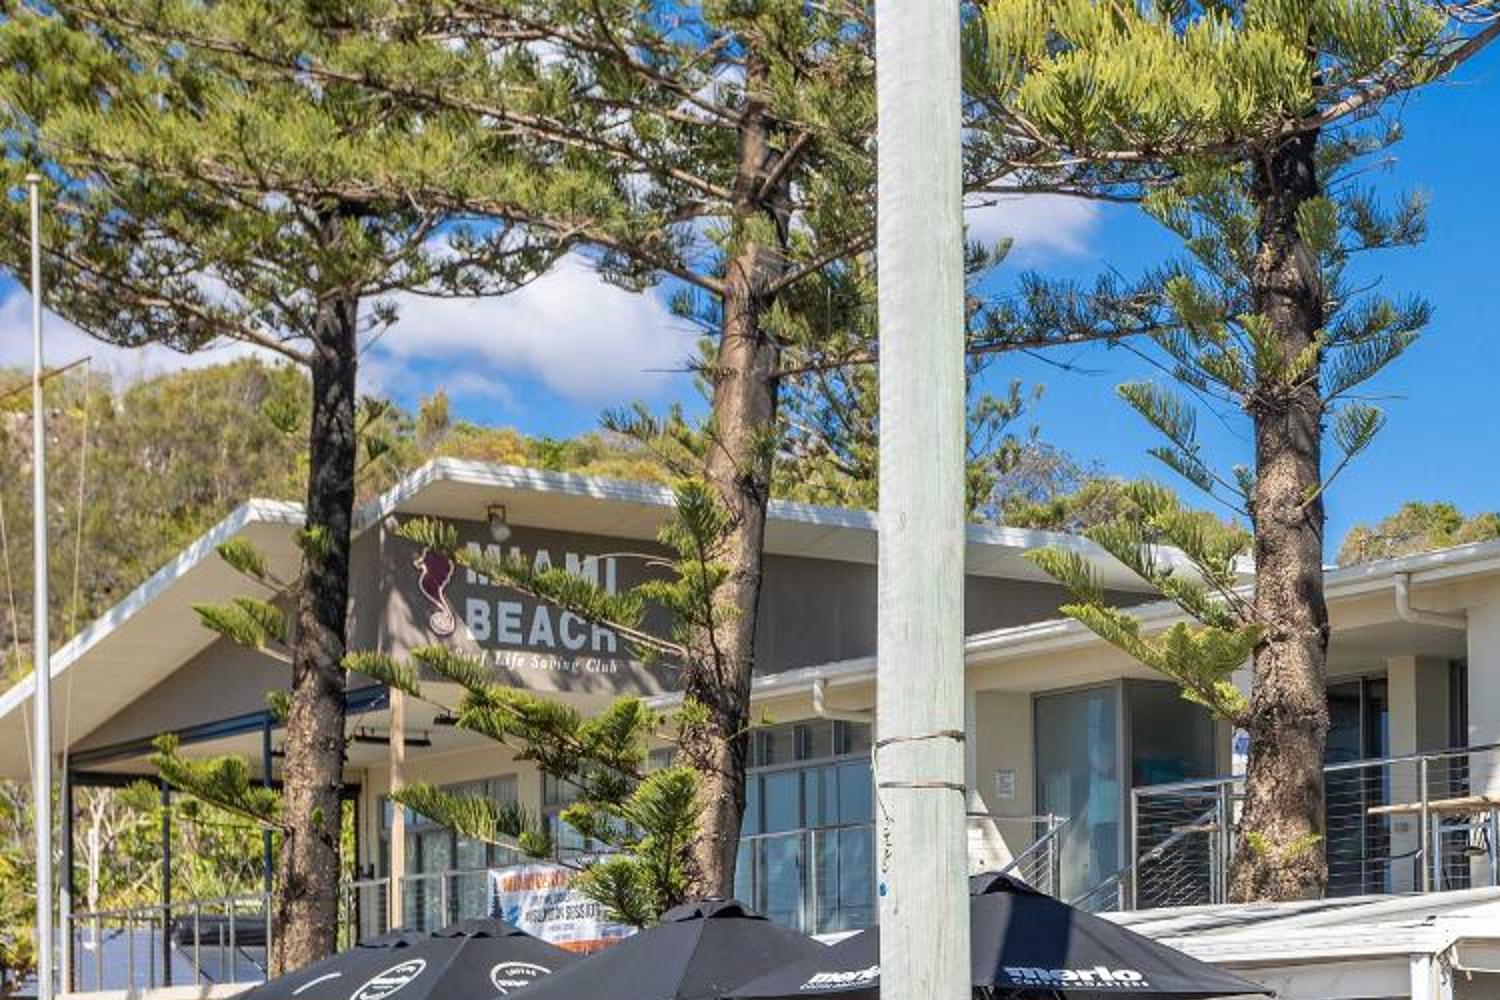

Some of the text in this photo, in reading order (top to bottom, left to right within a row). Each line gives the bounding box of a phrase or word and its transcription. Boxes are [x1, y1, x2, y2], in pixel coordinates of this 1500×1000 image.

[466, 597, 617, 652] BEACH
[495, 651, 525, 670] Life
[585, 660, 617, 673] Club
[1003, 965, 1143, 981] merlo
